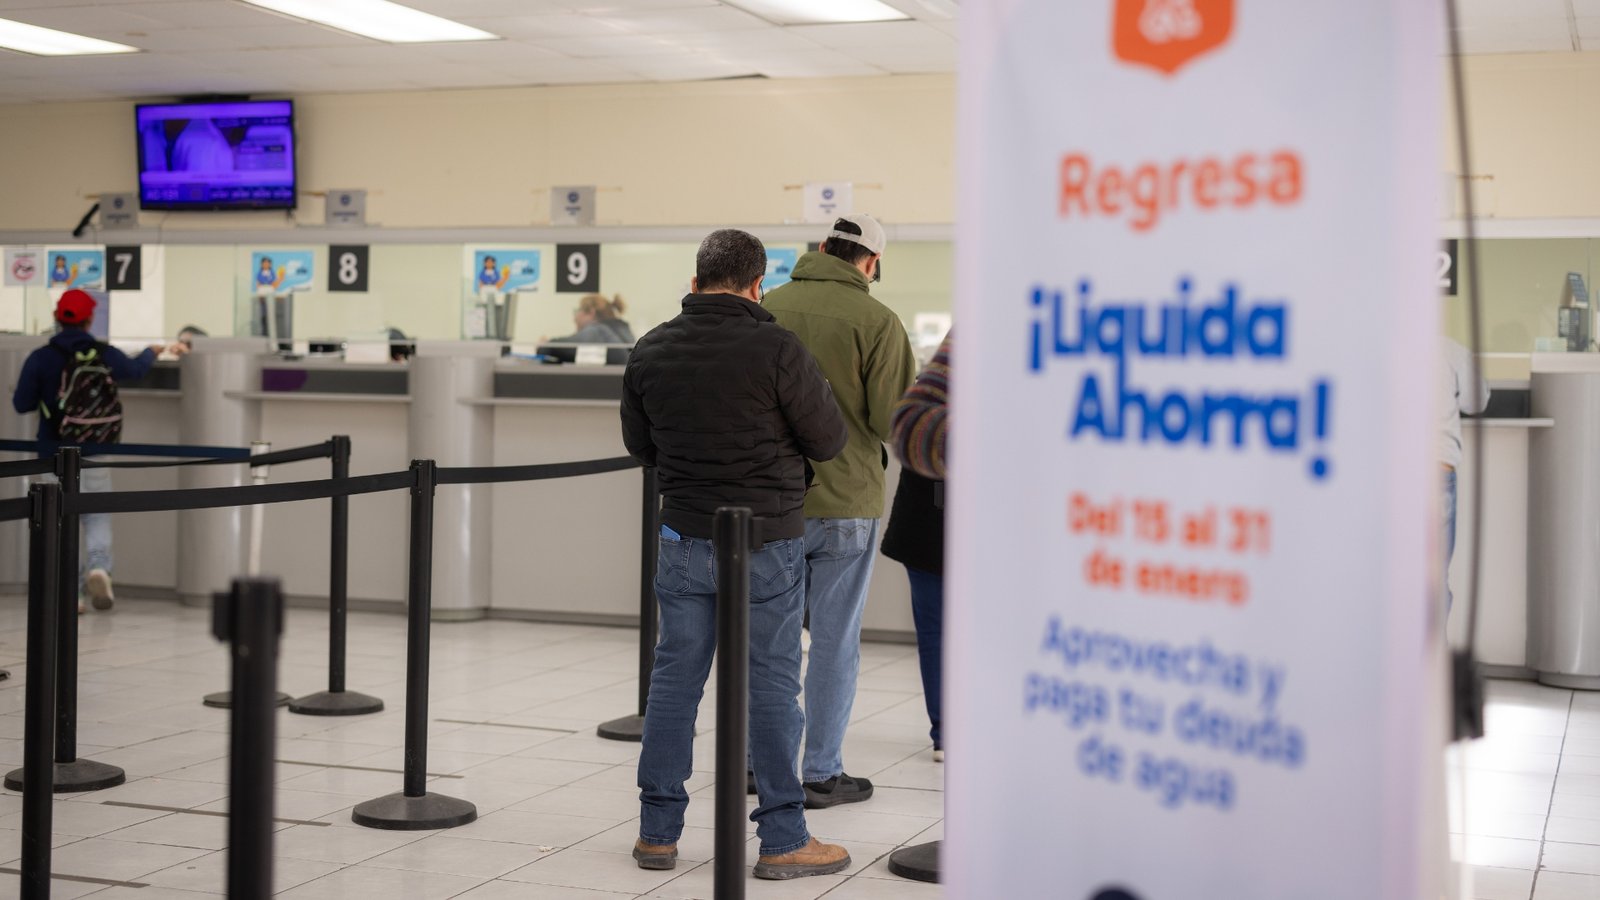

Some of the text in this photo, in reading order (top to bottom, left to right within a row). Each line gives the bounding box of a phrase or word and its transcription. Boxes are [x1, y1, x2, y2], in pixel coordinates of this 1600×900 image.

[1057, 147, 1308, 235] Regresa
[114, 253, 133, 285] 7
[338, 252, 358, 285] 8
[567, 252, 588, 285] 9
[1027, 277, 1289, 374] ¡Liquida
[1067, 372, 1333, 481] Ahorra!
[1066, 489, 1271, 556] Del 15 al 31
[1082, 547, 1252, 609] de enero
[1041, 612, 1287, 716] Aprovecha y
[1023, 671, 1307, 771] paga tu deuda
[1075, 734, 1237, 812] de agua
